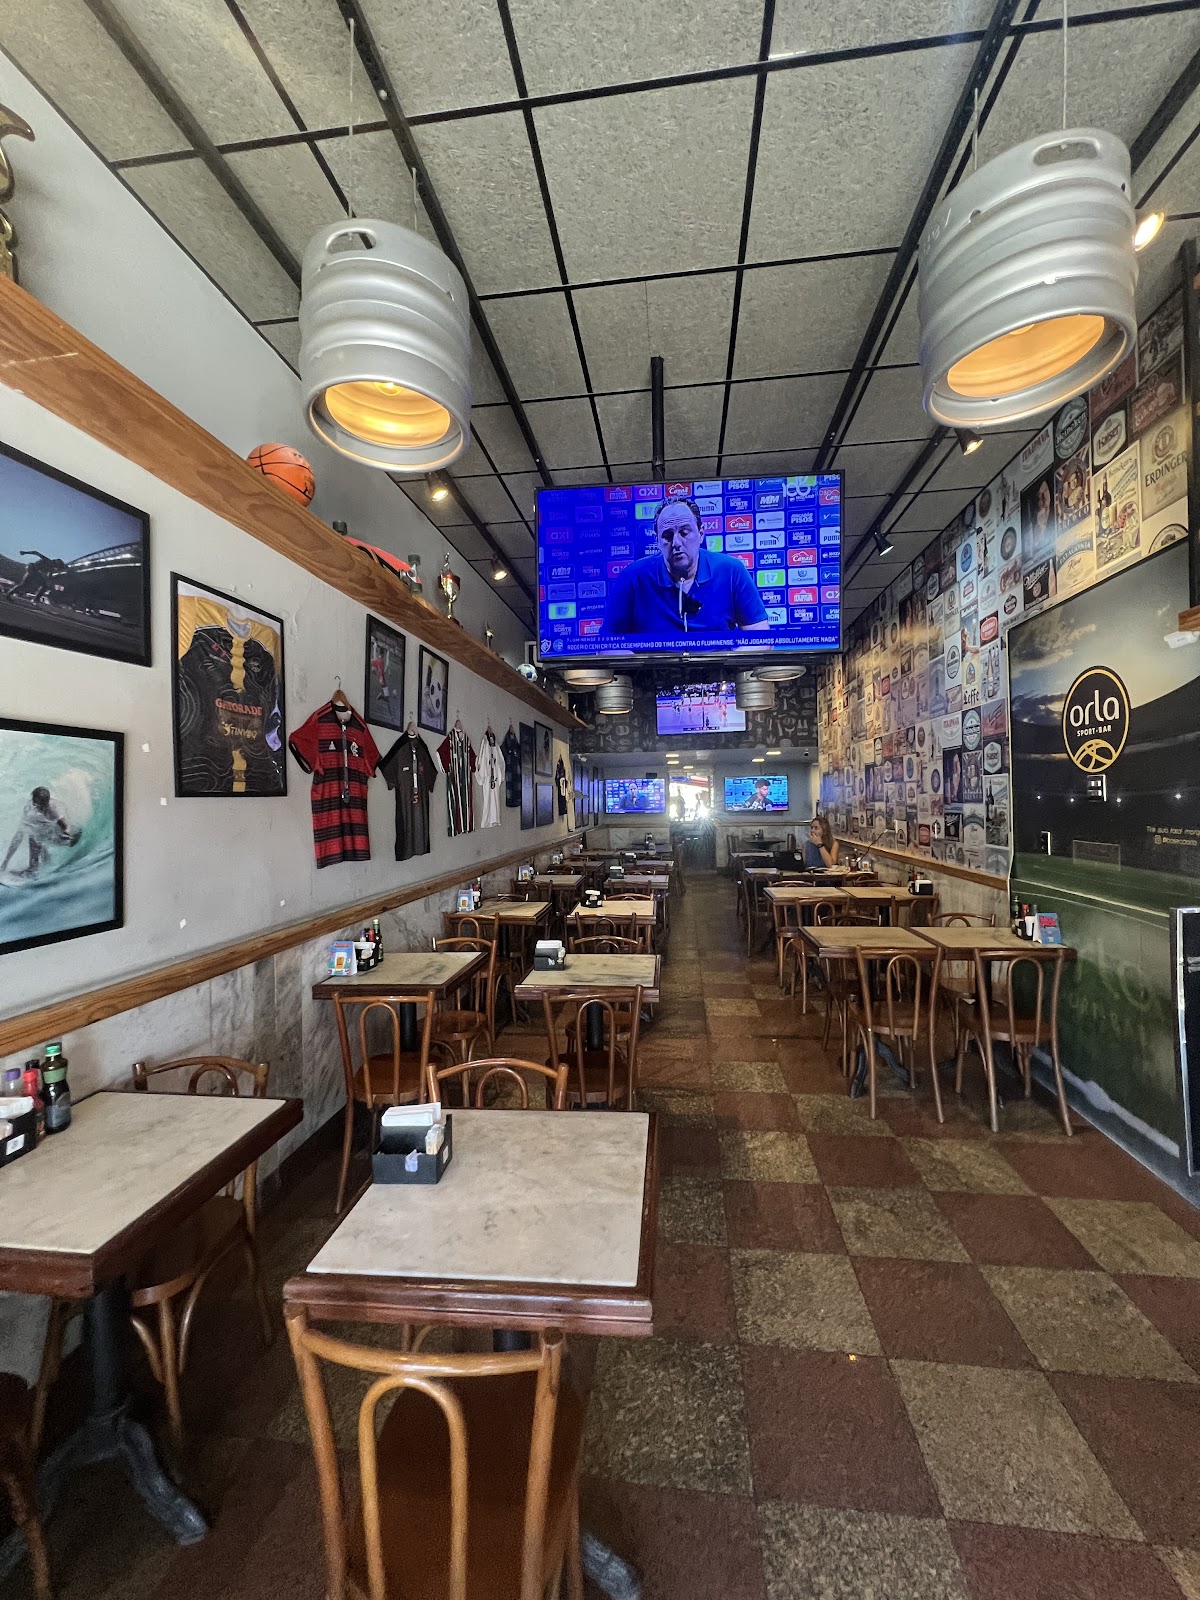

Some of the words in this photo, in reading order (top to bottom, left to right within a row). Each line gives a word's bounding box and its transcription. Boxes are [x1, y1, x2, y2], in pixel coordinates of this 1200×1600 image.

[1144, 450, 1188, 488] ERDINGER
[620, 641, 655, 649] DESEMPENHO
[662, 640, 675, 648] TIME
[774, 636, 820, 644] ABSOLUTAMENTE
[215, 697, 263, 716] GATORADE
[963, 688, 979, 706] Leffe
[1069, 689, 1120, 727] orla
